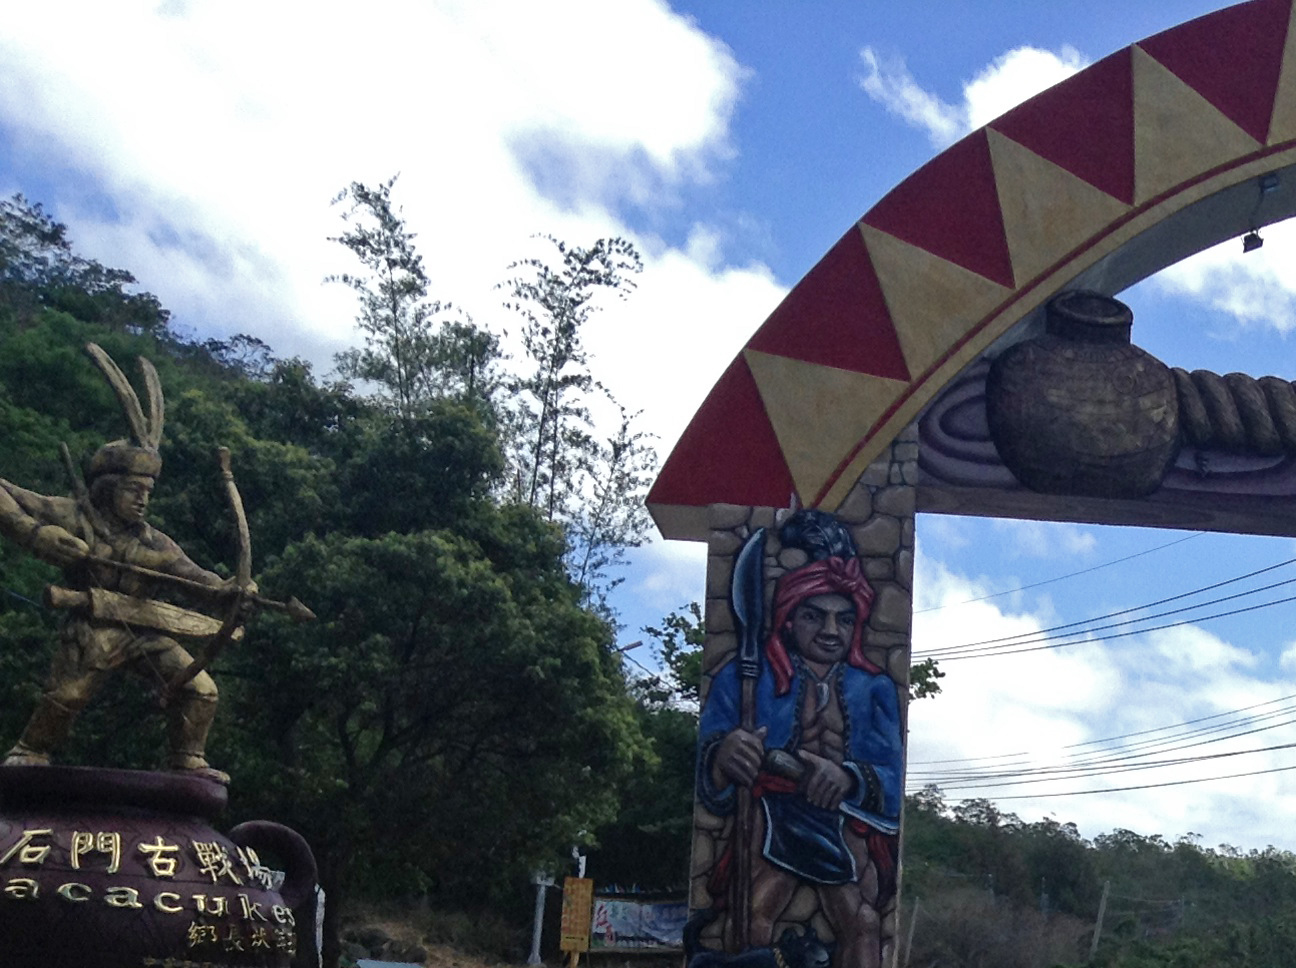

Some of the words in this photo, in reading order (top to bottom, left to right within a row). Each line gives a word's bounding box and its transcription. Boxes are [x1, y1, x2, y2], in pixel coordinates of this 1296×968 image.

[0, 828, 275, 890] 石門古戰場
